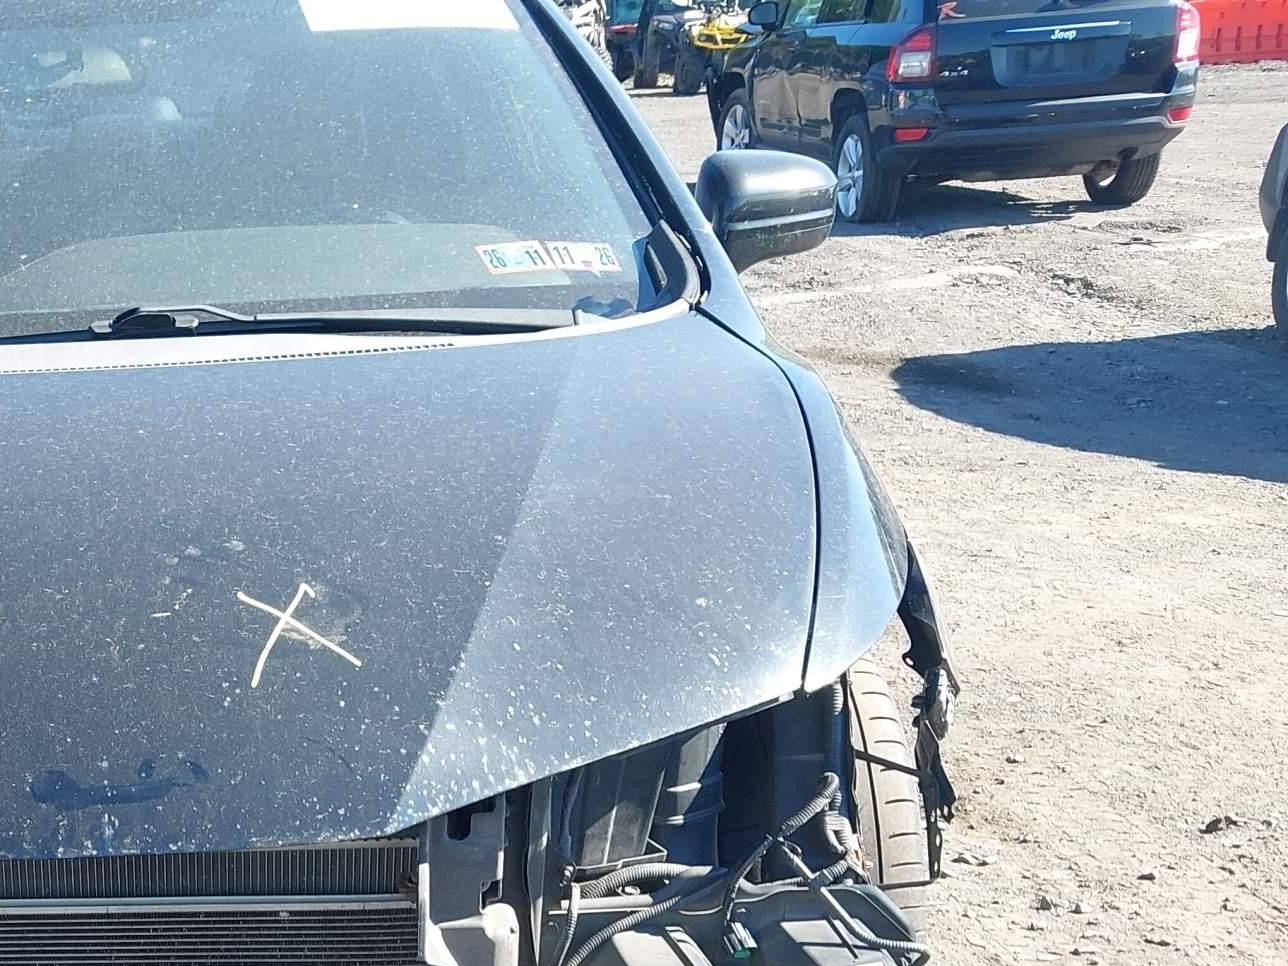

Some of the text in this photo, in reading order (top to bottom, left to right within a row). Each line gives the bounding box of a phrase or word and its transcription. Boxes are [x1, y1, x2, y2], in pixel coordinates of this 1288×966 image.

[1050, 29, 1078, 41] Jeep
[483, 249, 546, 269] 26 11
[552, 246, 616, 266] 11 26
